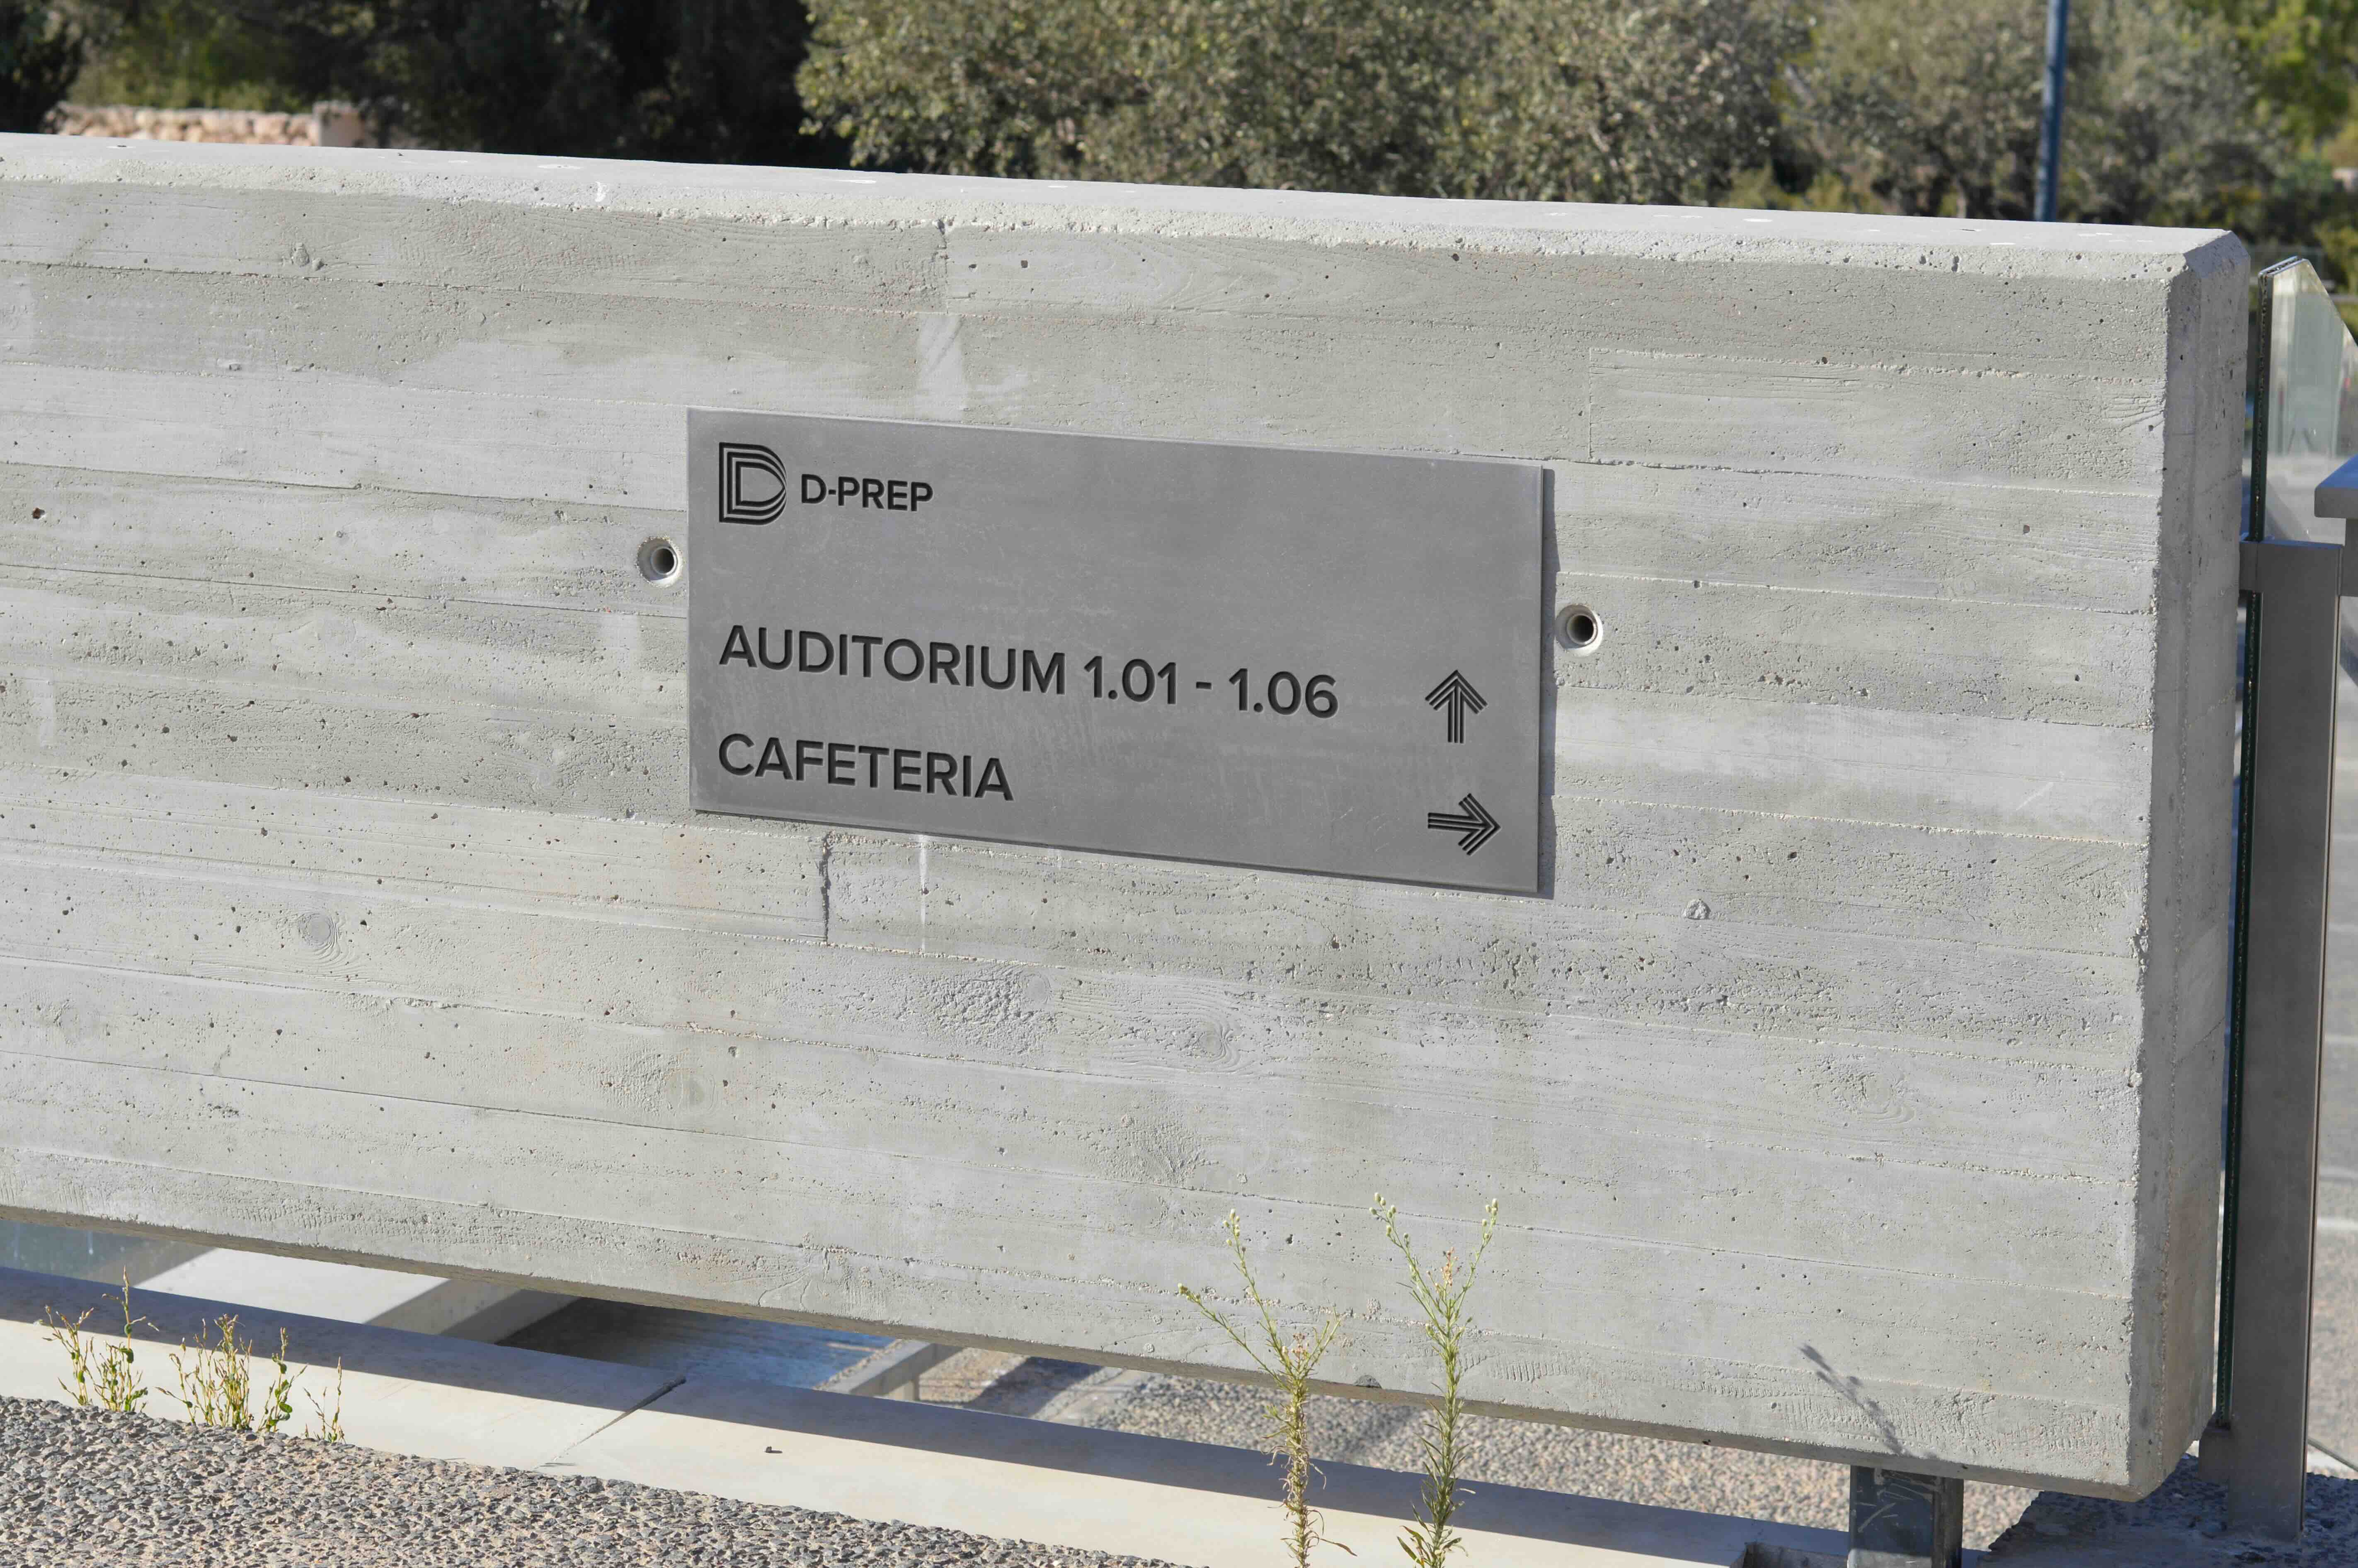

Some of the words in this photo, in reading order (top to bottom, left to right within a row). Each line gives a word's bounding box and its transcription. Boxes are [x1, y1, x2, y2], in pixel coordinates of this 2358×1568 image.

[801, 474, 933, 511] D-PREP
[719, 625, 1065, 695] AUDITORIUM
[1084, 655, 1176, 705] 1.01
[1229, 668, 1338, 718] 1.06
[719, 733, 1013, 801] CAFETERIA
